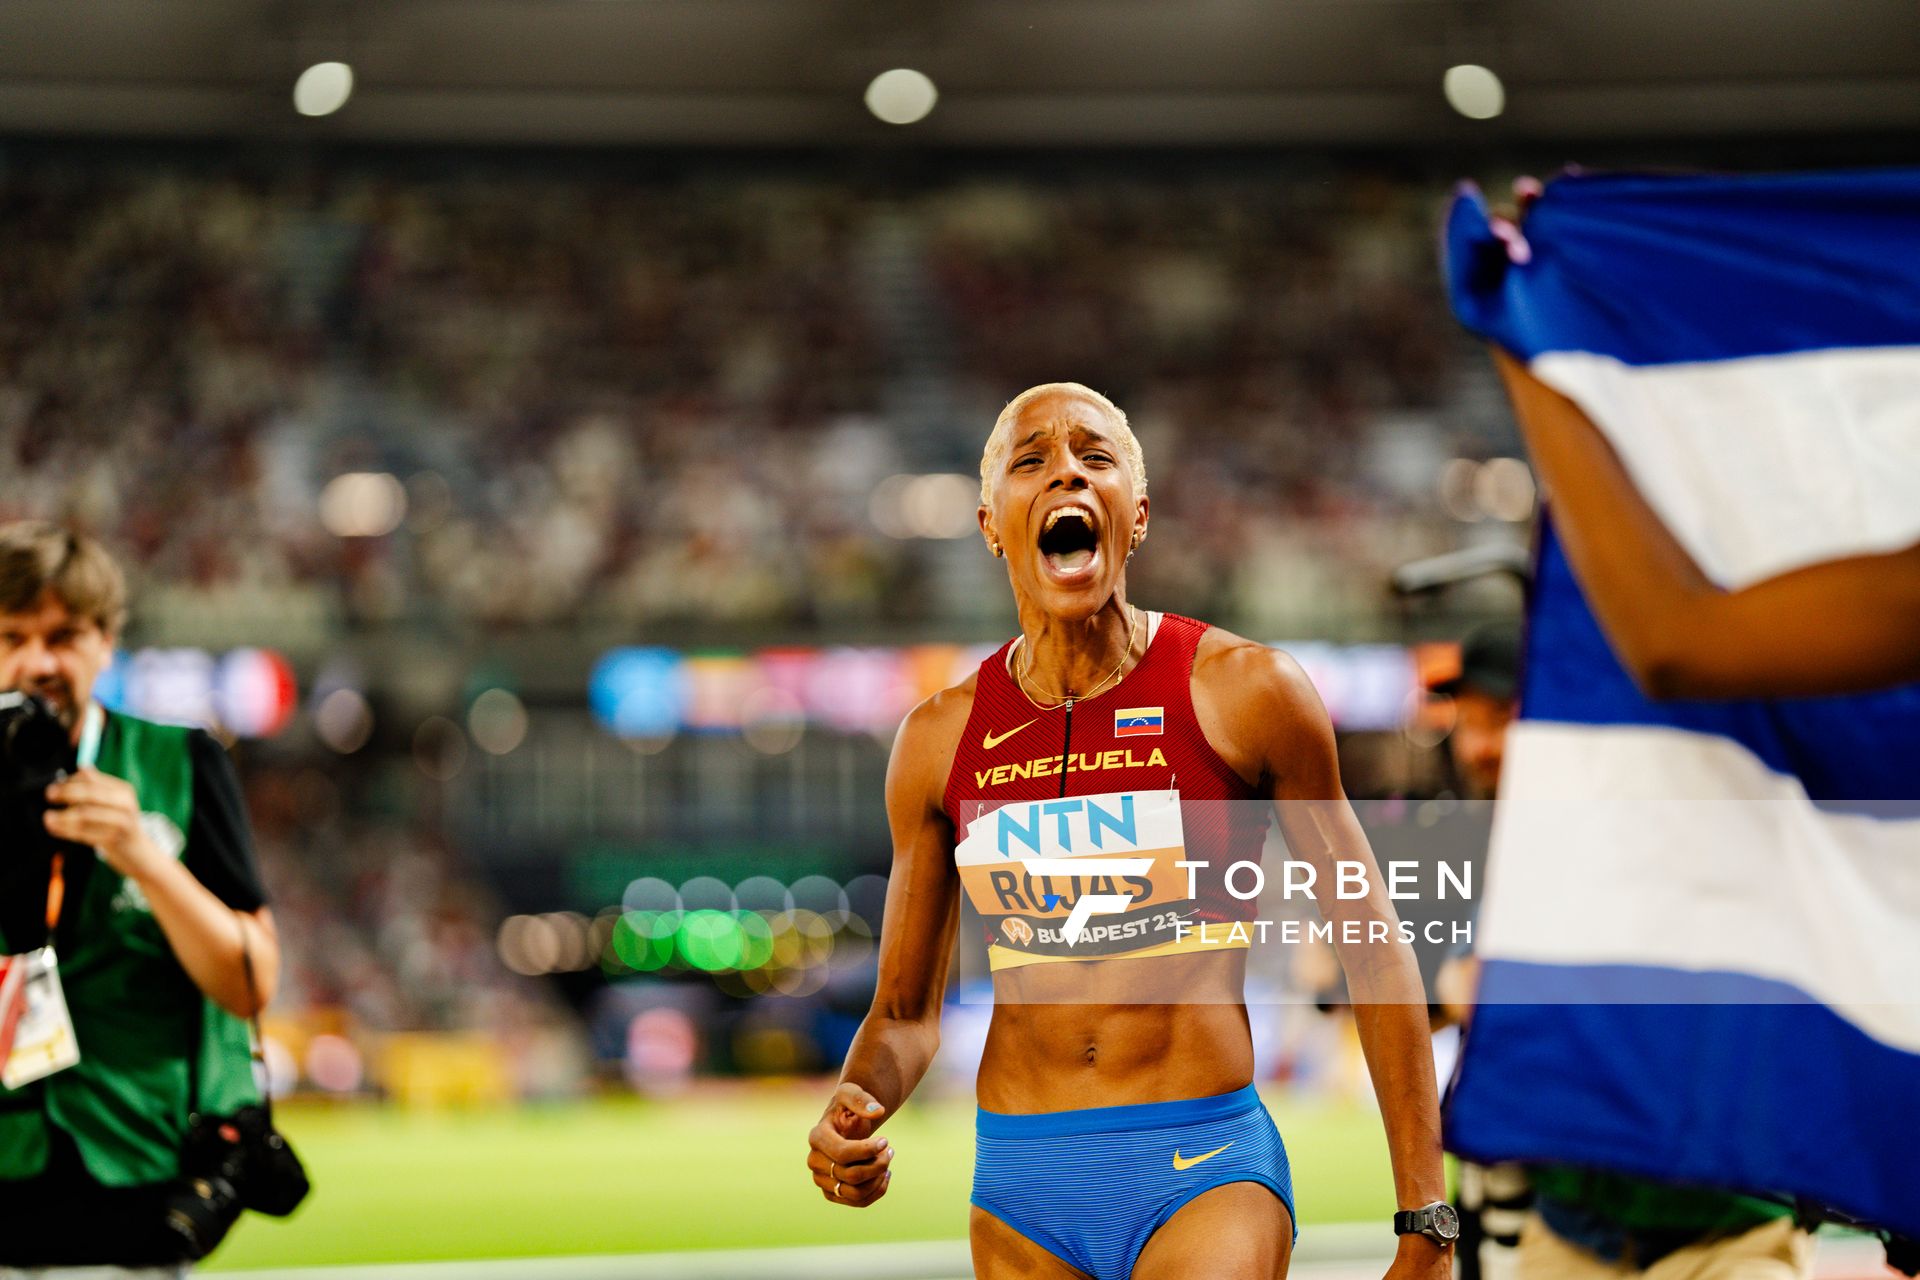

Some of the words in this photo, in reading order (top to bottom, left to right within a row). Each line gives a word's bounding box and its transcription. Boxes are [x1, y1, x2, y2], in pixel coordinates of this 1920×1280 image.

[974, 747, 1168, 789] VENEZUELA
[997, 795, 1137, 858] NTN
[1036, 917, 1150, 944] BUAPEST
[1151, 911, 1179, 931] 23
